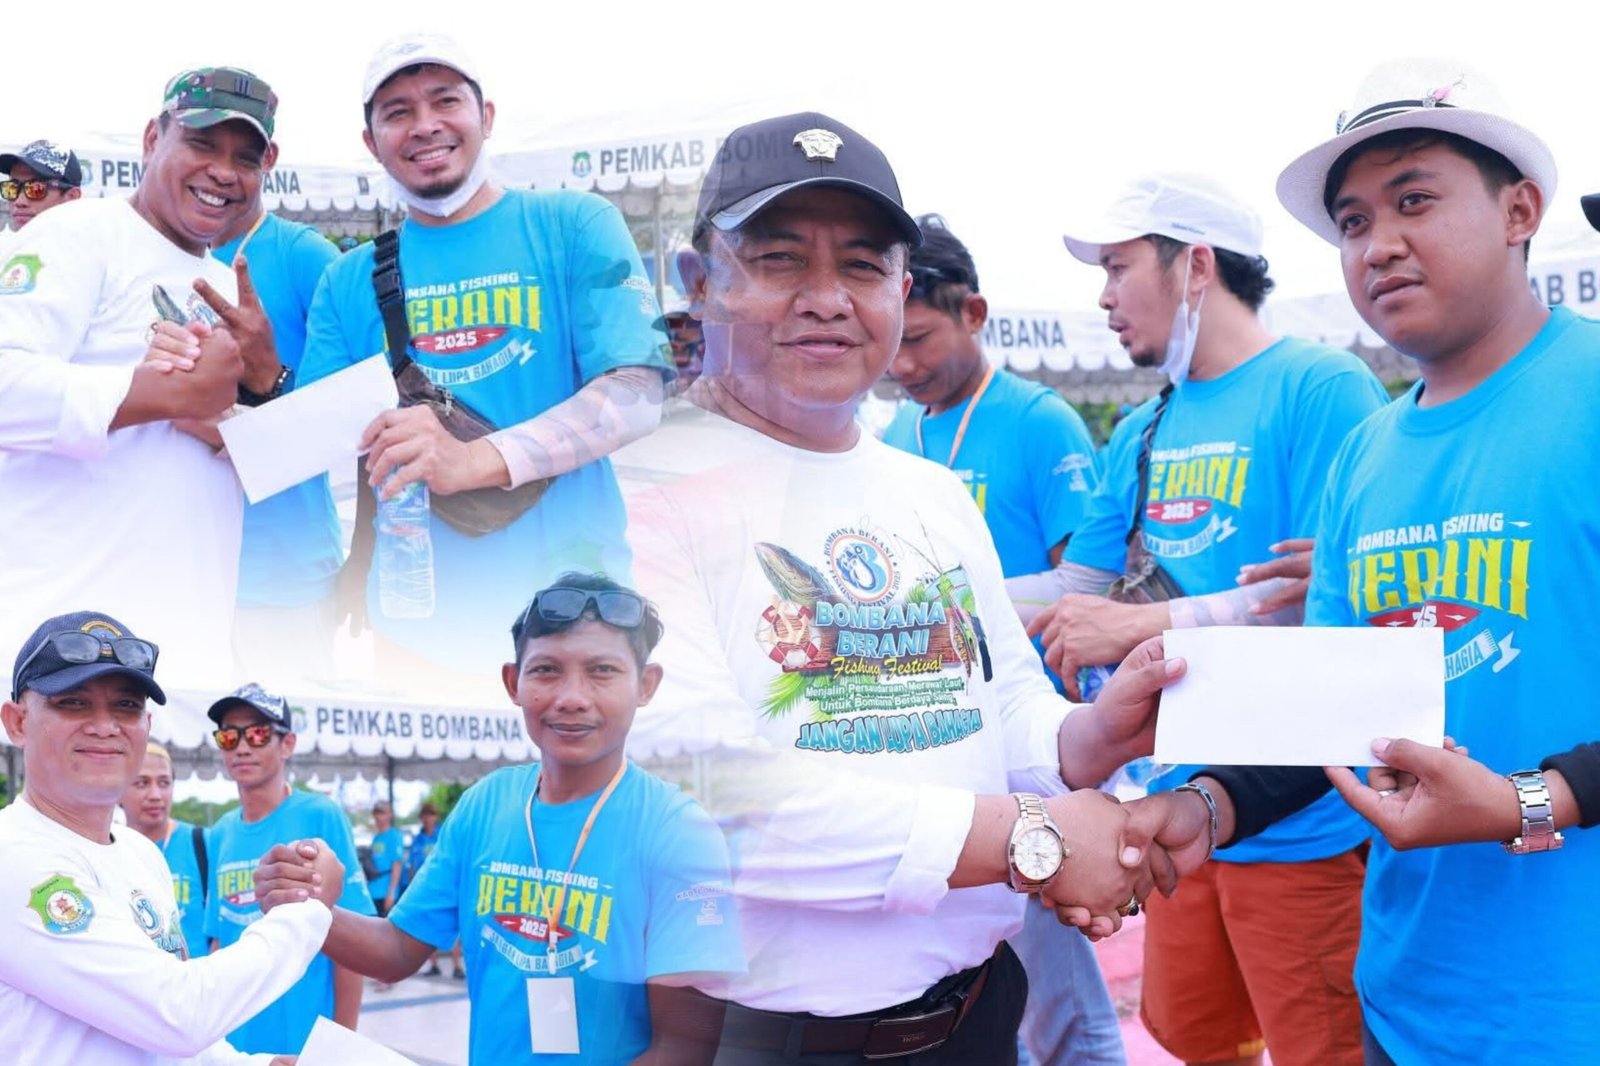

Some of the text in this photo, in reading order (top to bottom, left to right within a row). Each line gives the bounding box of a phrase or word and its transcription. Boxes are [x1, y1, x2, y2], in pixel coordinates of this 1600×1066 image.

[600, 139, 705, 176] PEMKAB
[101, 159, 302, 195] PEM ANA
[1530, 270, 1599, 306] AB B
[405, 286, 542, 336] ERANI
[434, 331, 477, 350] 2025
[982, 317, 1067, 348] MBANA
[1149, 457, 1249, 510] ERANI
[815, 601, 947, 630] BOMBANA
[836, 628, 930, 659] BERANI
[1444, 641, 1485, 680] HAGIA
[830, 654, 944, 681] Fishing Festival
[820, 694, 853, 713] Untuk
[316, 707, 523, 742] PEMKAB BOMBANA
[795, 714, 884, 753] JANGAN
[879, 712, 929, 753] LUPA
